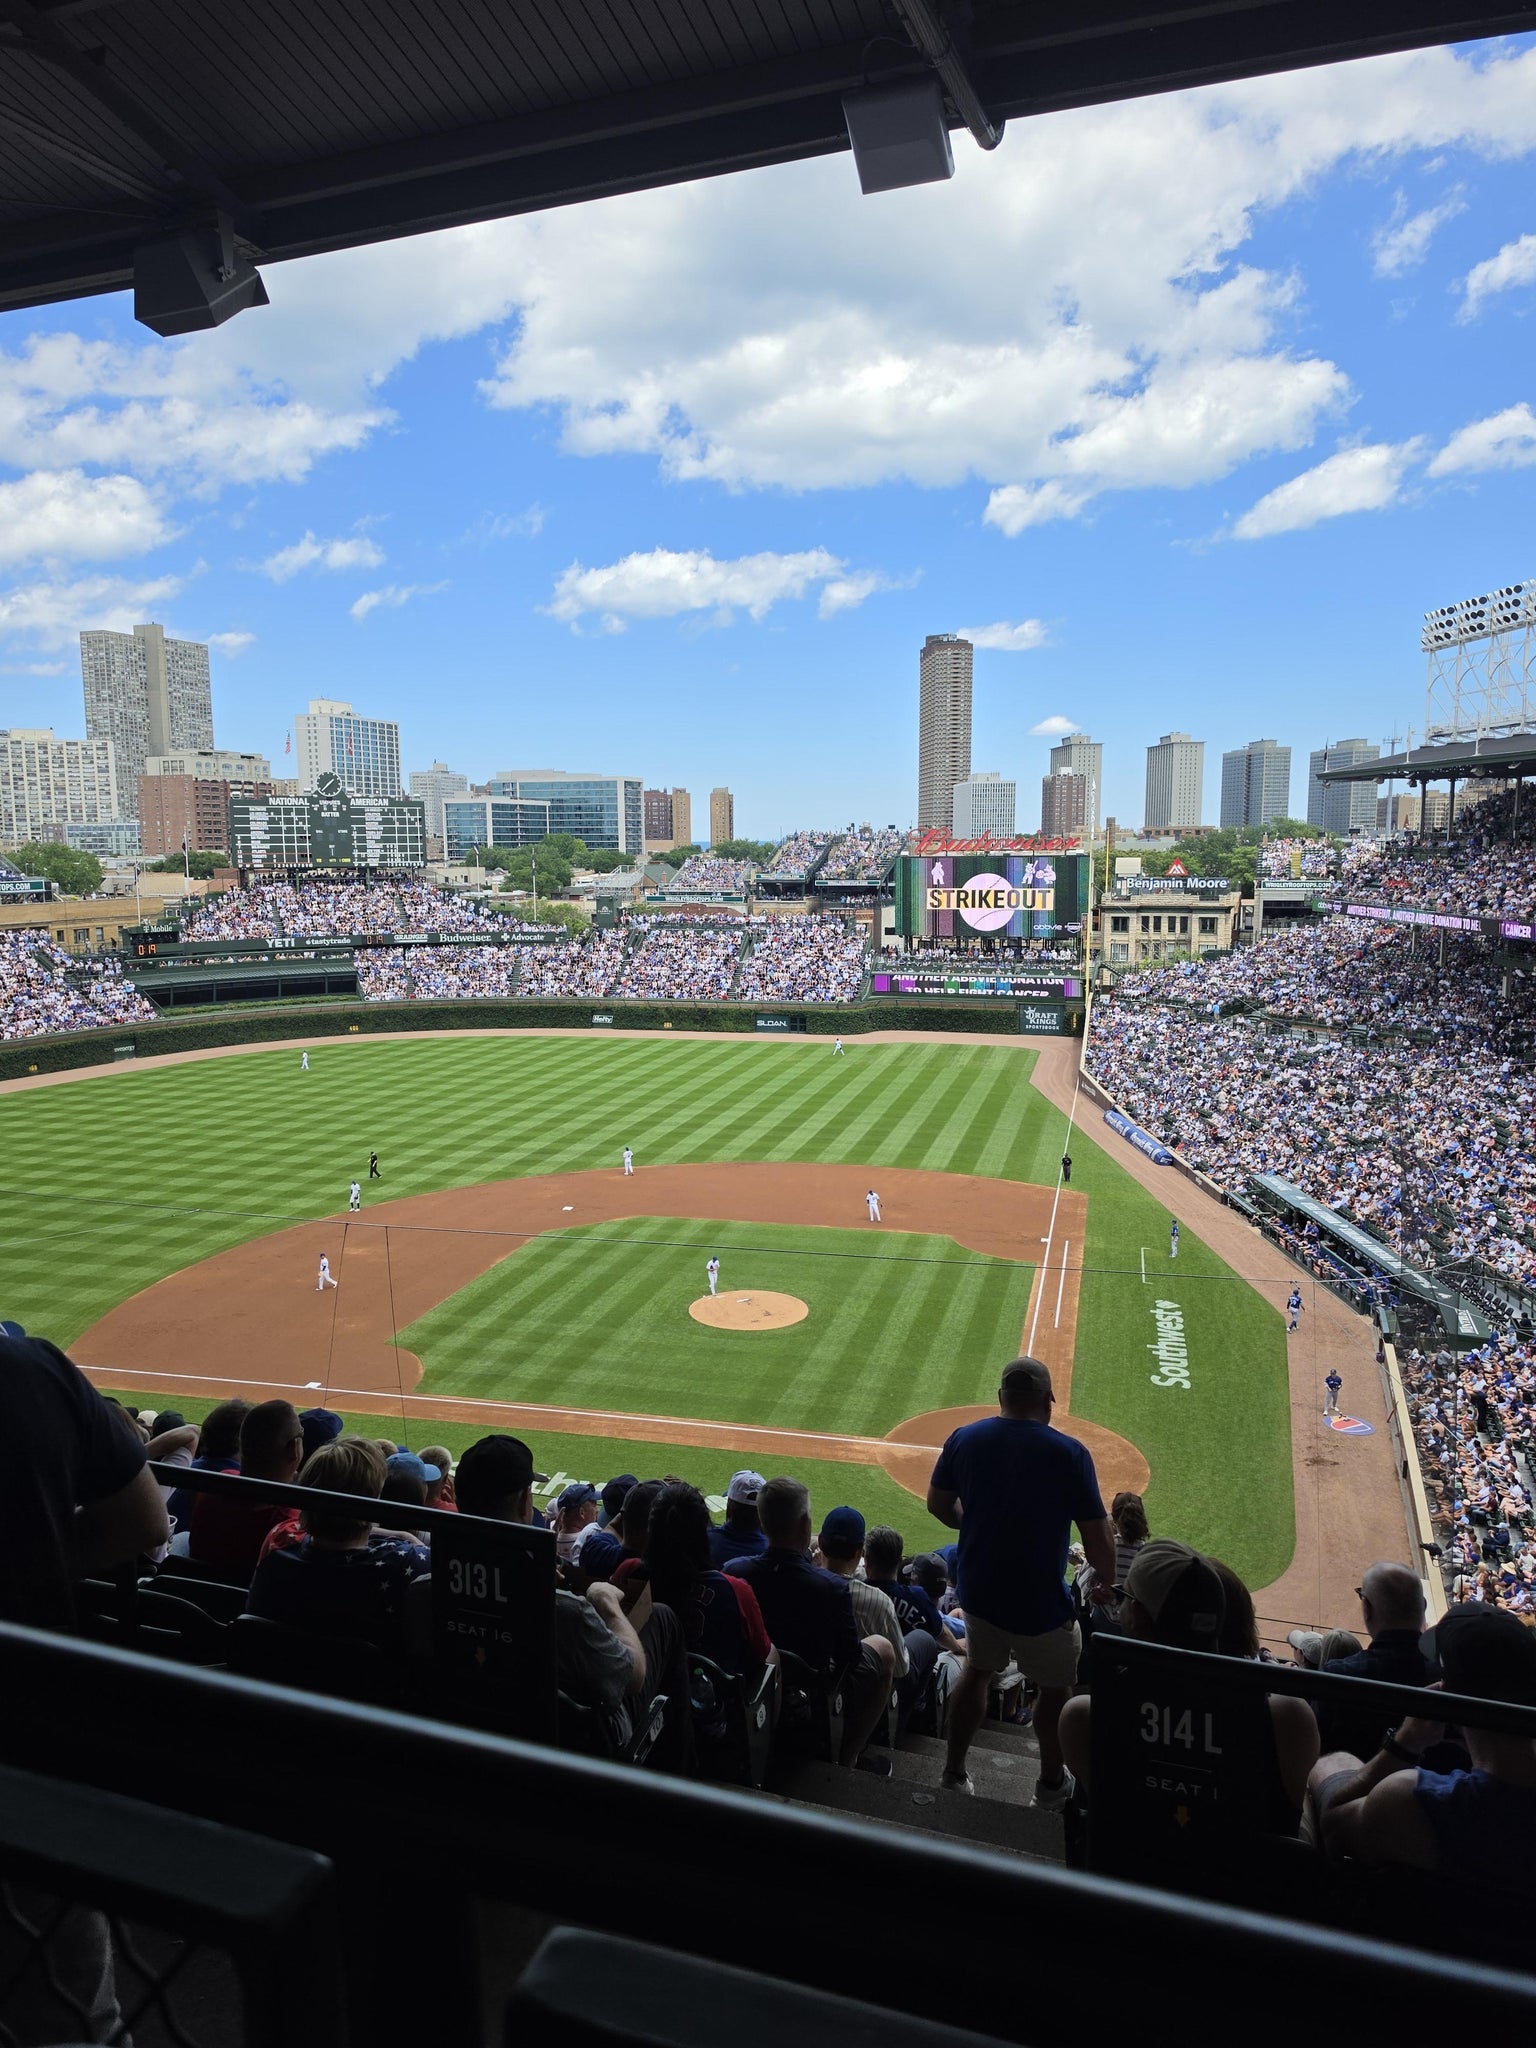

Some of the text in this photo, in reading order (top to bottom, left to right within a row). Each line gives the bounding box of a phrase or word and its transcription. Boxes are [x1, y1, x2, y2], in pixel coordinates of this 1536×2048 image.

[268, 797, 310, 806] NATIONAL
[350, 798, 389, 806] AMERICAN
[907, 826, 1081, 855] Budweiser
[1126, 877, 1228, 890] Benjamin Moore
[929, 889, 1051, 909] STRIKEOUT
[439, 932, 492, 943] Budweiser
[511, 933, 545, 942] Advocate
[1505, 923, 1532, 938] CANCER
[266, 938, 296, 948] YETI
[310, 937, 351, 946] tastytrade
[1025, 1009, 1058, 1020] DRAFT
[1146, 1308, 1192, 1389] Southwest
[449, 1558, 508, 1603] 313 L
[447, 1620, 513, 1643] SEAT 16
[1140, 1702, 1223, 1755] 314 L
[1145, 1776, 1202, 1797] SEAT
